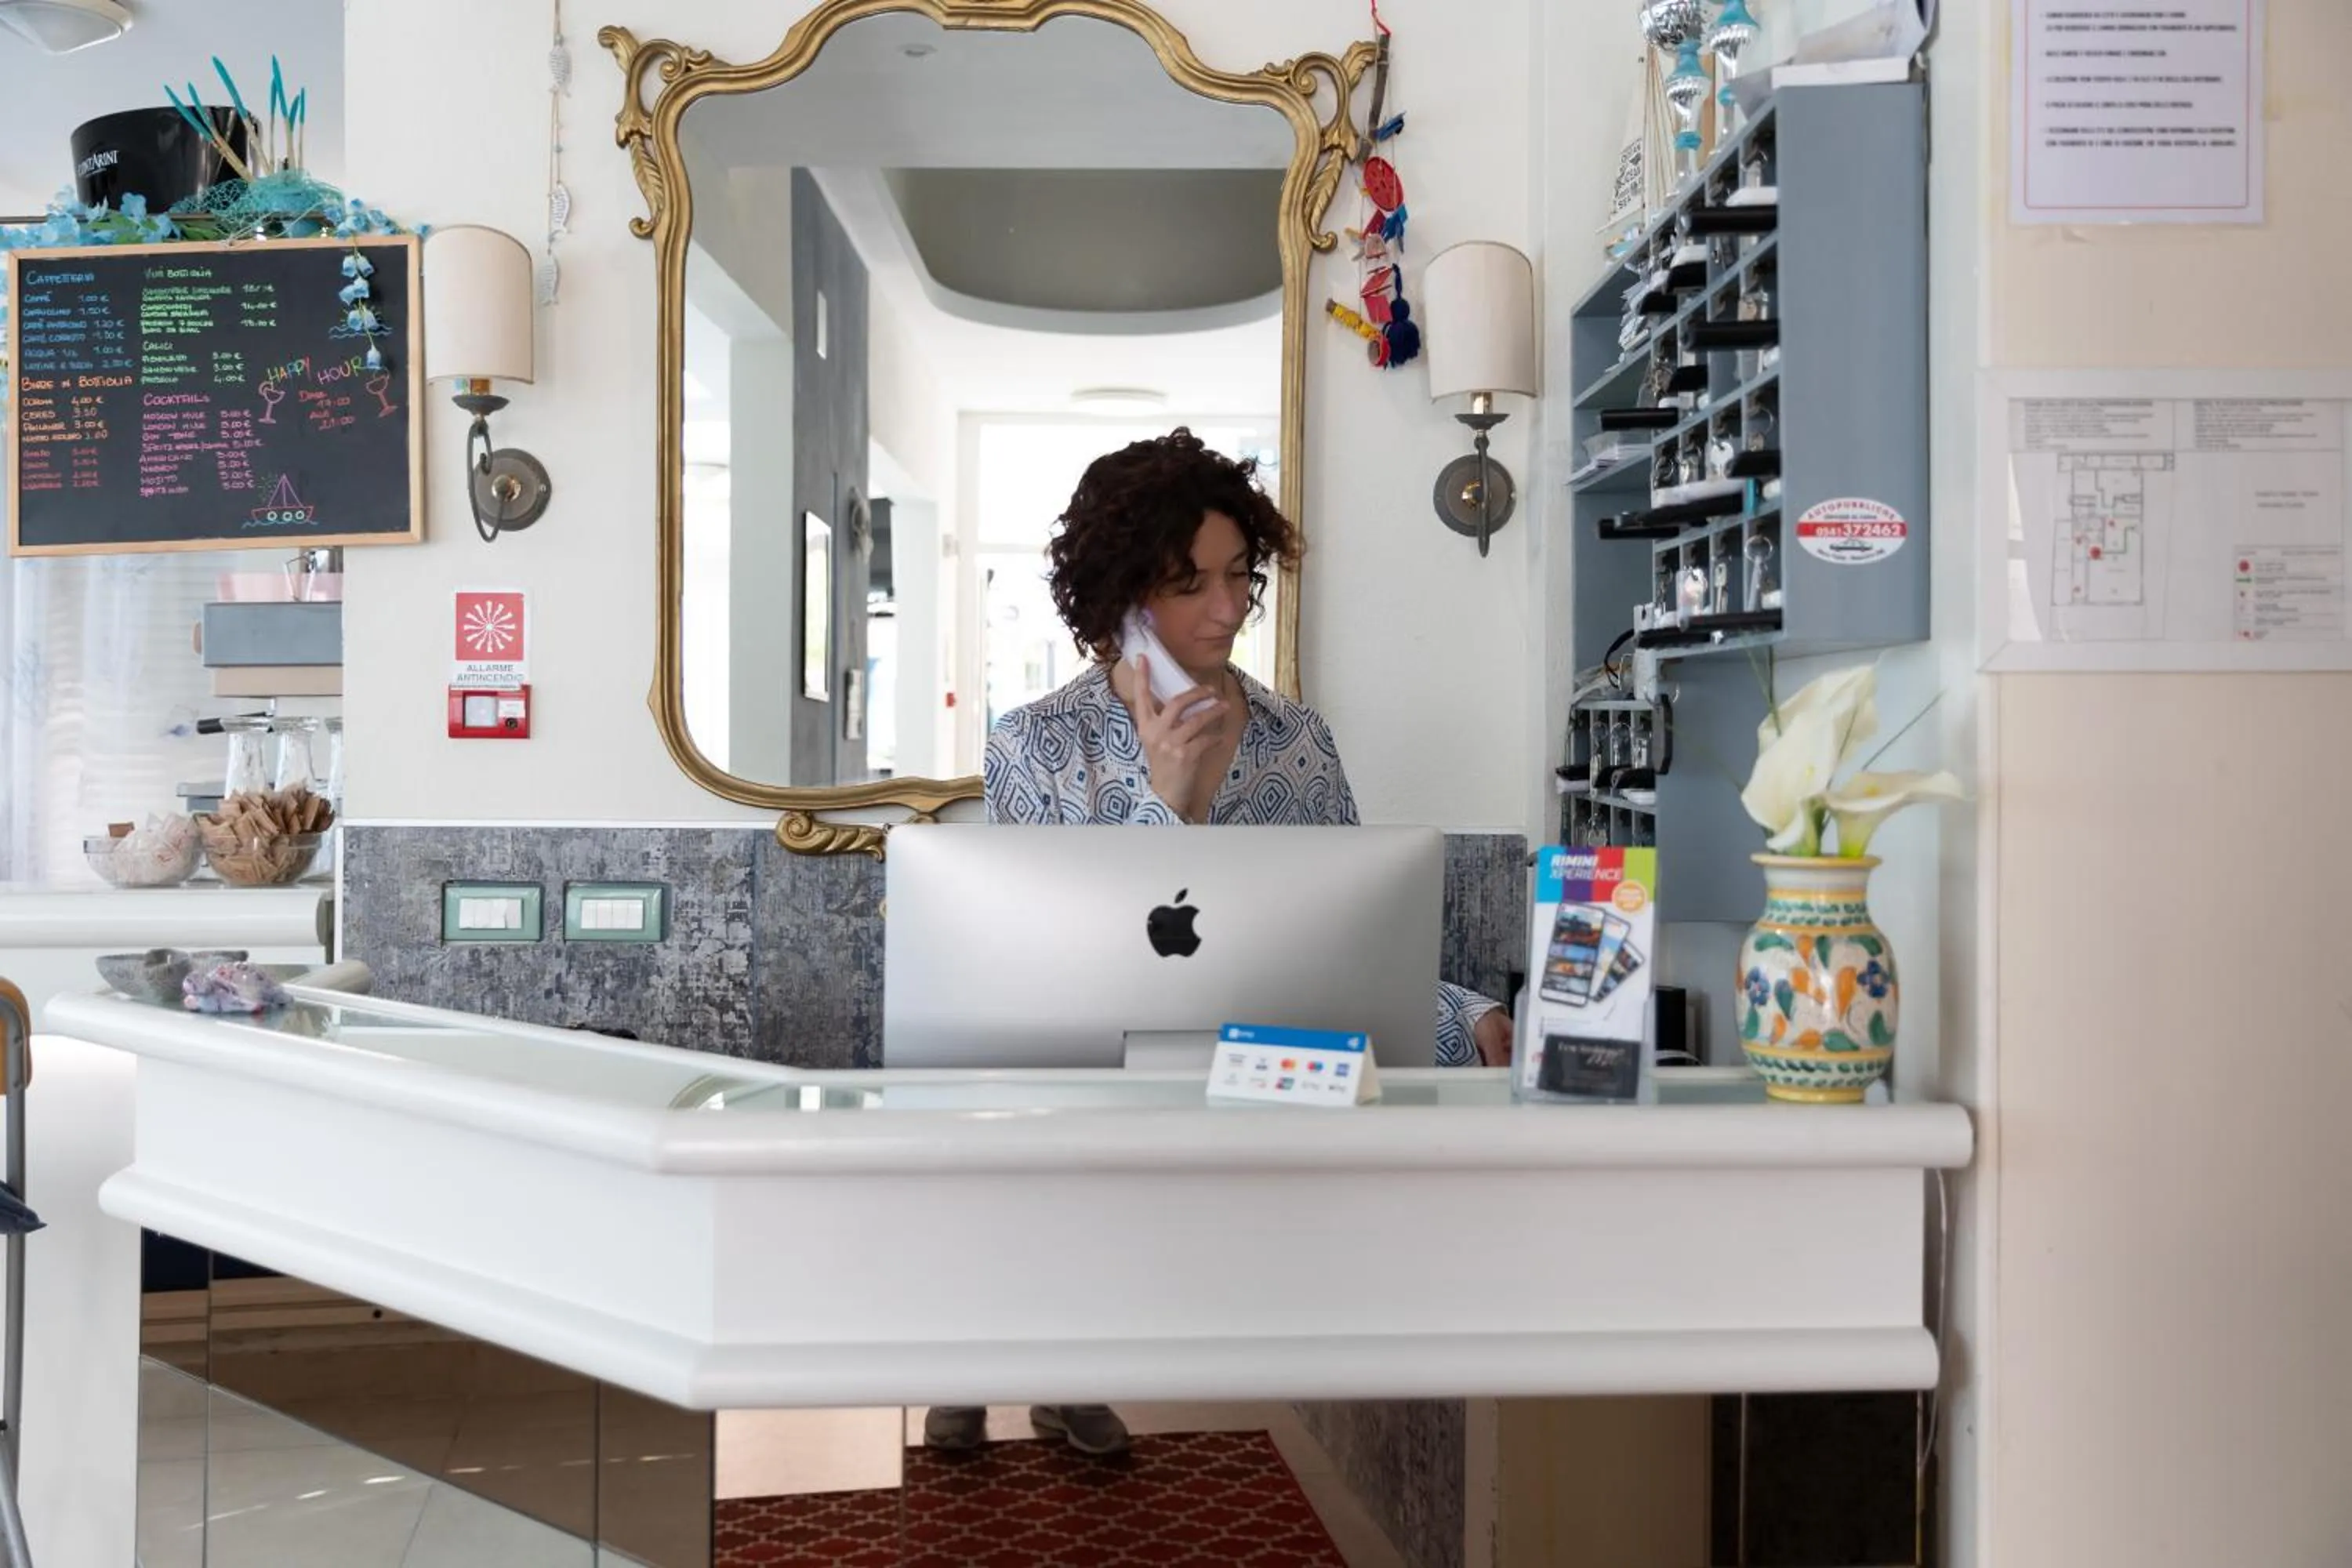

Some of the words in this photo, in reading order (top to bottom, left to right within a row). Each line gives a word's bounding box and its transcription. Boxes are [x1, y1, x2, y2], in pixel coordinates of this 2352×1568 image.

[267, 356, 312, 383] HAPPY
[318, 355, 363, 385] HOUR
[143, 393, 210, 406] COCKTAILS
[1843, 523, 1901, 536] 372462
[466, 664, 514, 673] ALLARME
[457, 673, 524, 682] ANTINCENDIO
[1551, 854, 1599, 866] RIMINI
[1549, 867, 1622, 880] XPERIENCE
